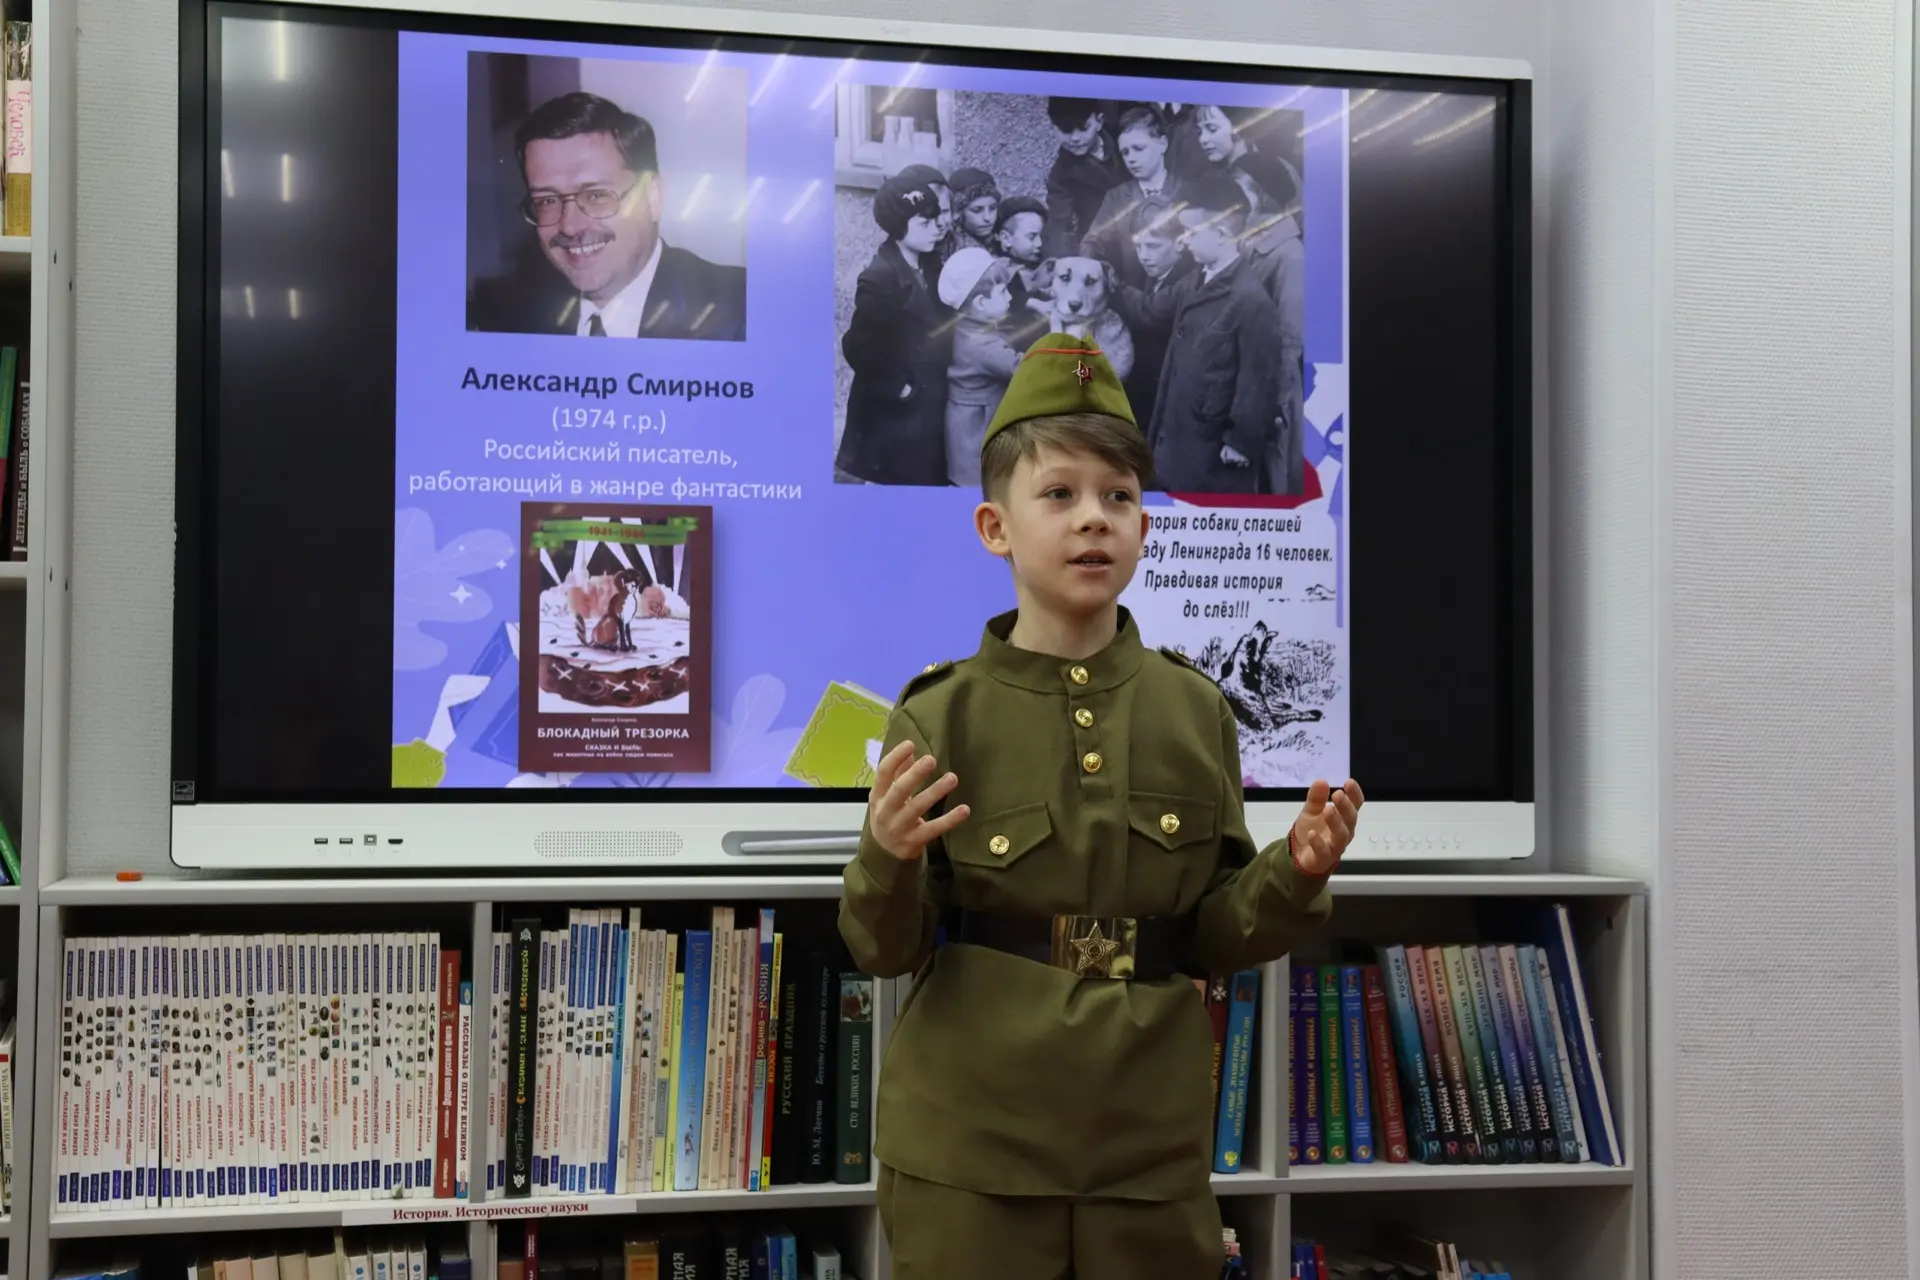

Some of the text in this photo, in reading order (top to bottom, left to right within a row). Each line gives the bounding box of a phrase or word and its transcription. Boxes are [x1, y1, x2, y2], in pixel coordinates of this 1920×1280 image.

[461, 366, 754, 401] Александр Смирнов
[21, 392, 30, 440] СОБАКАХ
[552, 407, 667, 432] (1974 г.р.)
[19, 449, 28, 480] БЫЛЬ
[484, 438, 739, 468] Российский писатель,
[408, 471, 562, 495] работающий
[589, 479, 664, 501] жанре
[671, 479, 801, 501] фантастики
[16, 491, 27, 543] ЛЕГЕНДЫ
[1149, 515, 1187, 533] тория
[1170, 541, 1250, 563] Ленинграда
[1256, 543, 1270, 560] 16
[1274, 546, 1333, 562] человек.
[1144, 570, 1283, 593] Правдивая история
[1183, 600, 1249, 618] до слёз!!!
[537, 724, 690, 740] БЛОКАДНЫЙ ТРЕЗОРКА
[1393, 958, 1406, 998] РОССИЯ
[1415, 957, 1425, 985] ВЕКА
[1454, 960, 1464, 986] ВЕКА
[1432, 960, 1452, 1036] НОВОЕ ВРЕМЯ
[461, 1015, 469, 1069] РАССКАЗЫ
[754, 963, 769, 1087] Наша родина РОССИЯ
[781, 983, 796, 1114] РУССКИЙ ПРАЗДНИК
[814, 1052, 825, 1085] Беседы
[1306, 1017, 1317, 1118] УМНИКИ УМНИЦЫ
[1327, 1016, 1340, 1116] УМНИКИ УМНИЦЫ
[1349, 1017, 1366, 1117] УМНИКИ УМНИЦЫ
[1376, 1018, 1398, 1116] УМНИКИ УМНИЦЫ
[850, 1035, 860, 1128] СТО ВЕЛИКИХ РОССИЯН
[813, 1100, 823, 1134] Лотман
[1227, 1091, 1235, 1118] САМЫЕ
[1422, 1086, 1436, 1132] ИСТОРИЯ
[1441, 1086, 1455, 1132] ИСТОРИЯ
[1459, 1089, 1473, 1134] ИСТОРИЯ
[1481, 1089, 1496, 1134] ИСТОРИЯ
[1498, 1084, 1512, 1129] ИСТОРИЯ
[1518, 1085, 1531, 1131] ИСТОРИЯ
[1535, 1084, 1550, 1130] ИСТОРИЯ
[1558, 1086, 1572, 1132] ИСТОРИЯ
[460, 1115, 468, 1161] ВЕЛИКОМ
[811, 1151, 821, 1165] Ю.
[812, 1136, 822, 1148] М.
[392, 1202, 588, 1220] История. Исторические науки
